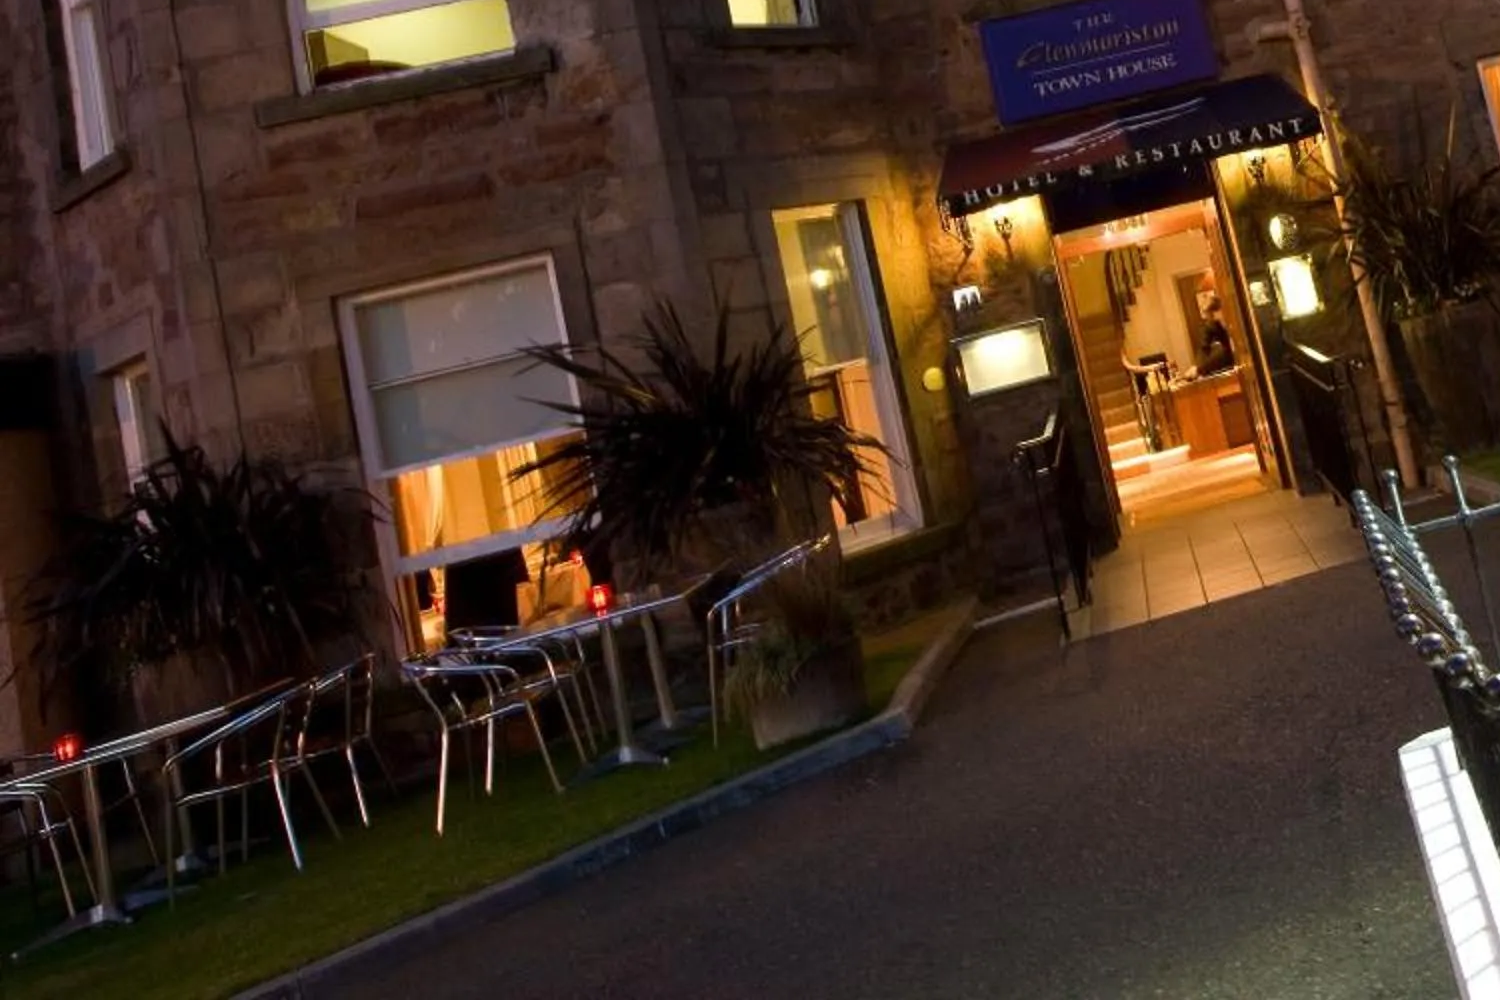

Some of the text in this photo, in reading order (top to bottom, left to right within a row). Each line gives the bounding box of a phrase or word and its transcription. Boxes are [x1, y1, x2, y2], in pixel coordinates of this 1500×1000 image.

[1073, 13, 1113, 32] THE
[1033, 53, 1178, 97] TOWN HOUSE
[962, 117, 1304, 206] HOTEL & RESTAURANT
